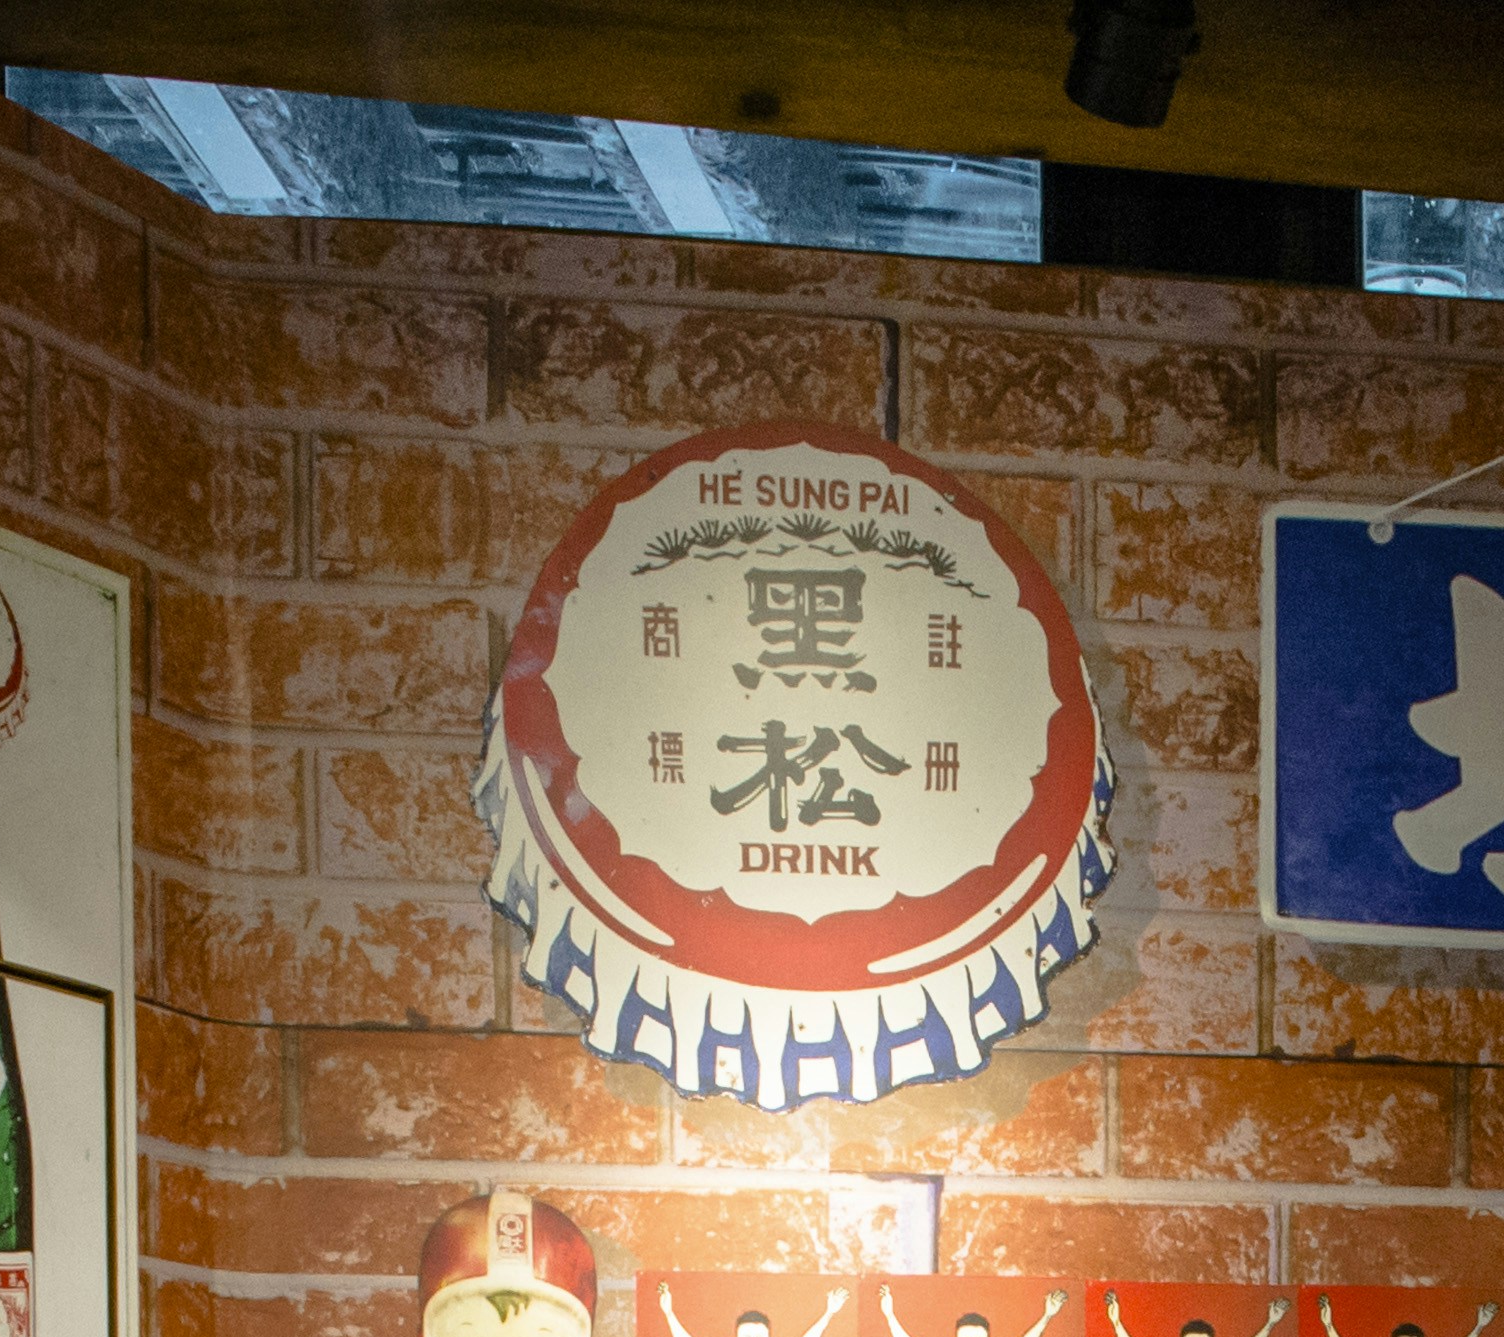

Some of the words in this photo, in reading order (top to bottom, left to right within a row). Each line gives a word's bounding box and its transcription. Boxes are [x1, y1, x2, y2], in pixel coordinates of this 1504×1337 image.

[698, 472, 743, 507] HE
[756, 476, 851, 513] SUNG
[858, 481, 911, 517] PAI
[642, 603, 686, 785] 商標
[708, 565, 913, 833] 黑松
[739, 841, 881, 878] DRINK
